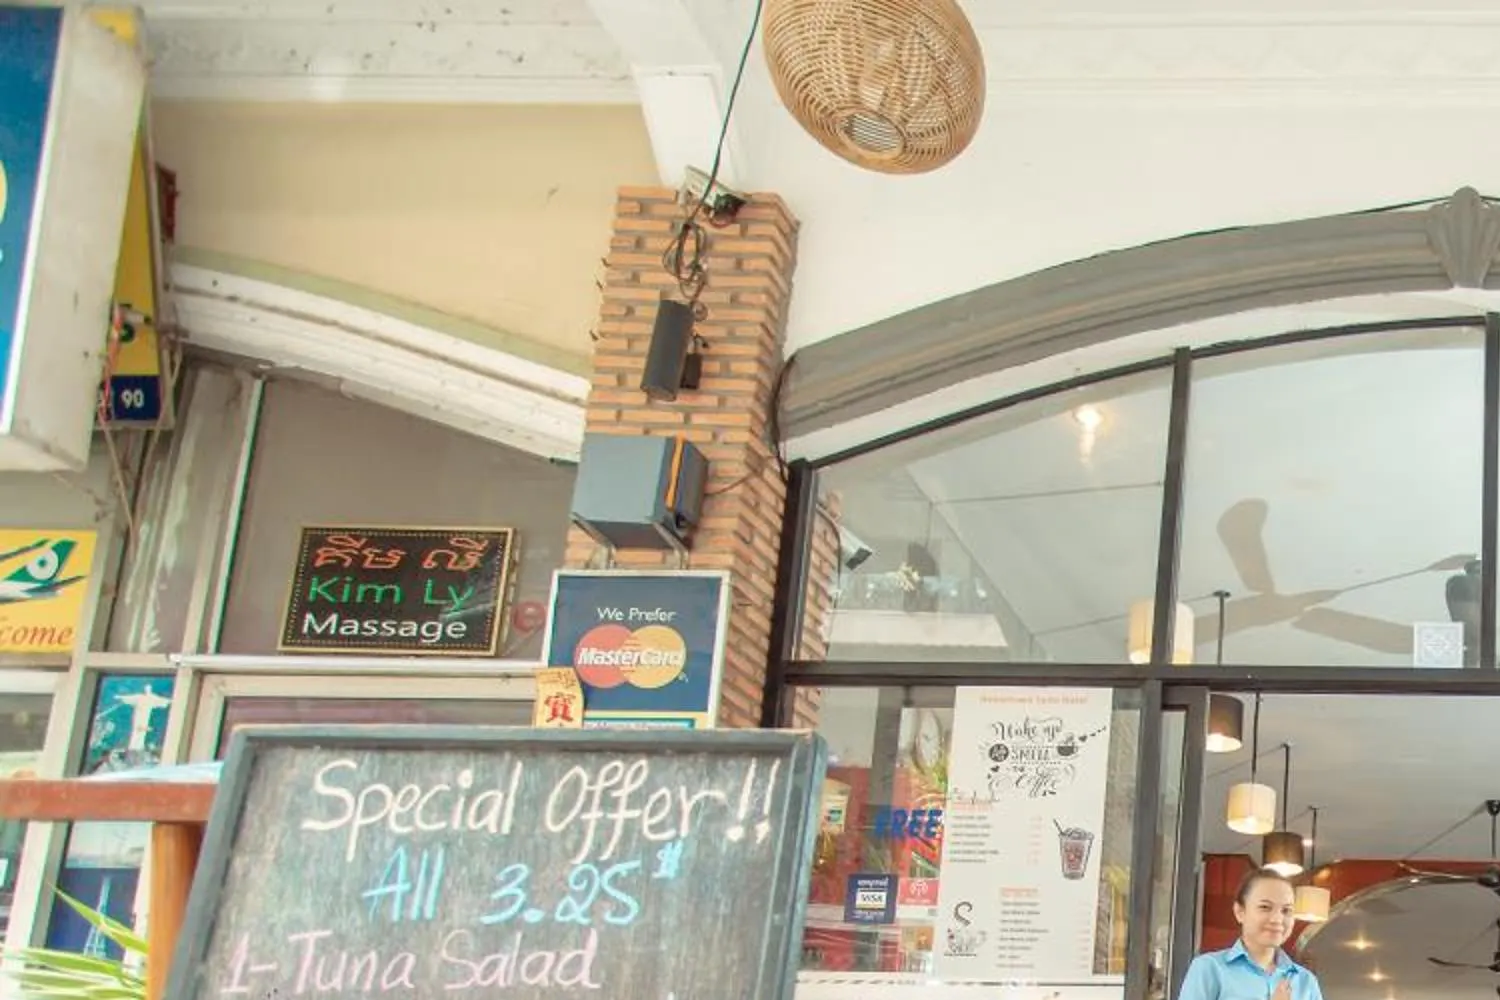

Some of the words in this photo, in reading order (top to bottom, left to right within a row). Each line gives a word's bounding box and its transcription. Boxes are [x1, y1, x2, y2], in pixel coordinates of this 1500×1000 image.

[307, 576, 402, 604] Kim
[423, 578, 474, 611] Ly
[302, 612, 468, 644] Massage
[597, 607, 625, 621] We
[628, 607, 678, 622] Prefer
[577, 647, 684, 667] MasterCard
[303, 758, 520, 862] Special
[362, 845, 446, 923] All
[442, 927, 602, 991] Salad
